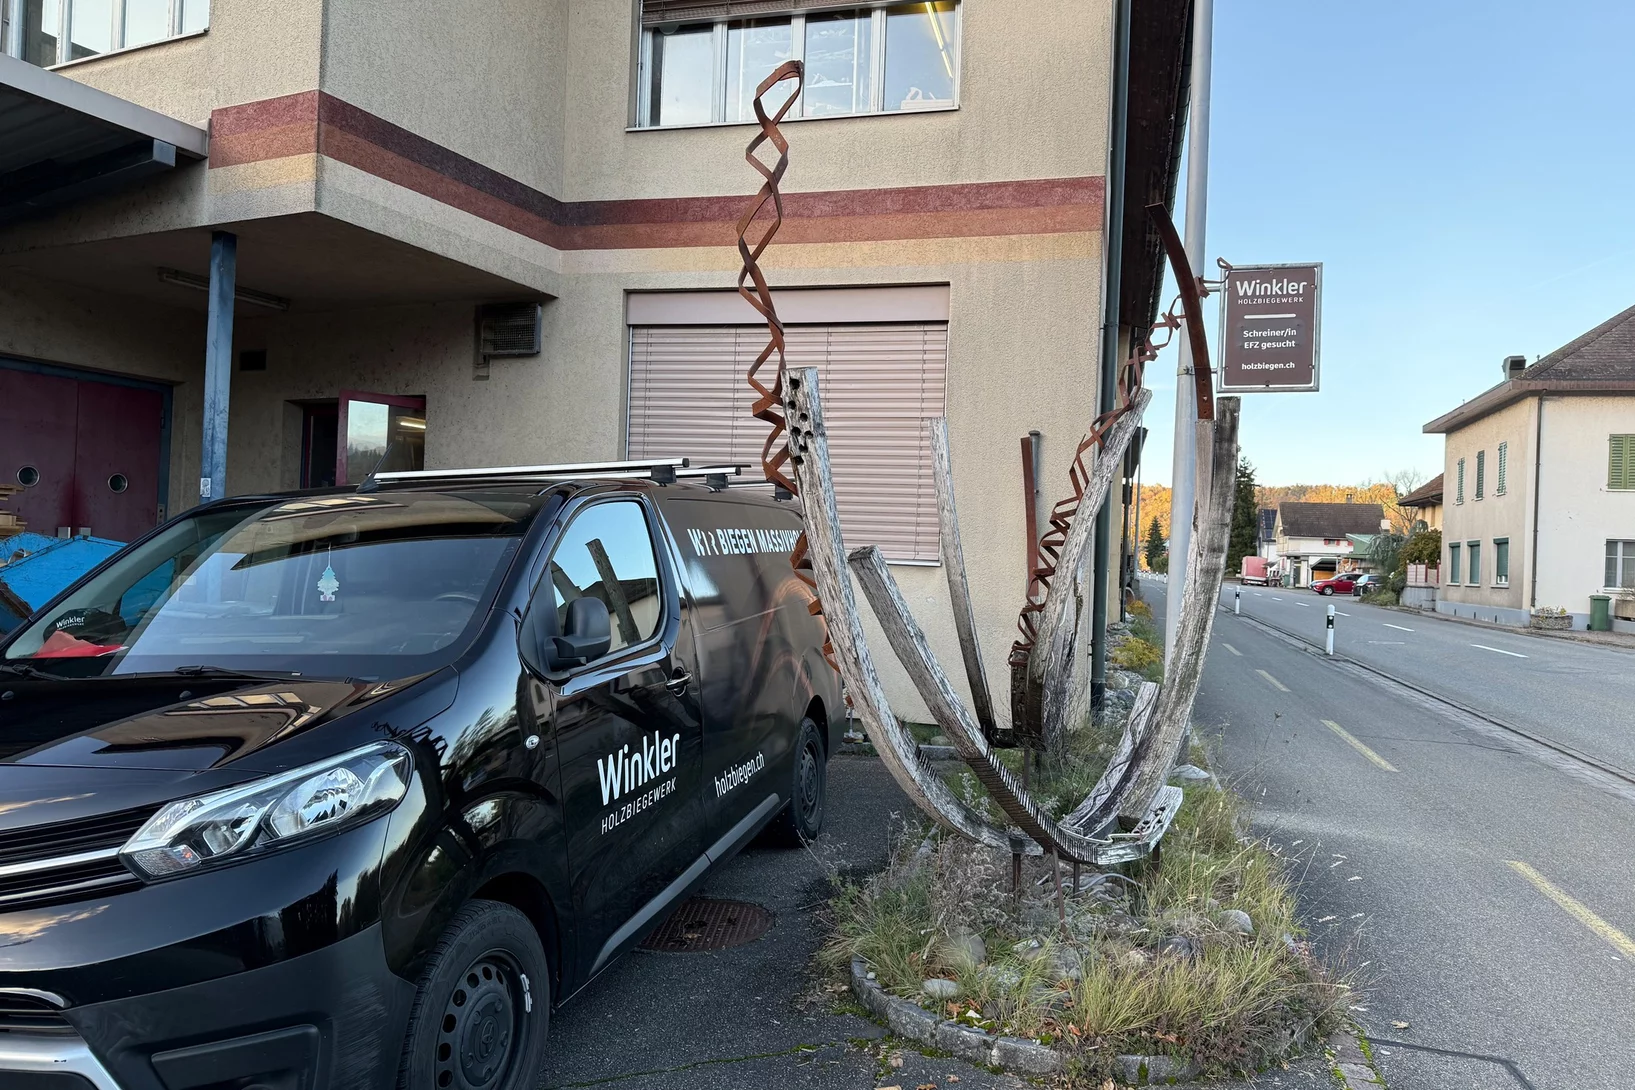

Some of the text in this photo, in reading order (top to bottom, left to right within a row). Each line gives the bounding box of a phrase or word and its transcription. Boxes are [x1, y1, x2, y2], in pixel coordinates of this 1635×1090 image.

[1236, 279, 1307, 296] Winkler
[1238, 297, 1304, 305] HOLZBIEGEWERK
[1243, 328, 1296, 337] Schreiner/in
[1244, 340, 1296, 350] EFZ gesucht
[1241, 362, 1295, 370] holzbiegen.ch
[716, 528, 759, 555] BIEGEN
[56, 616, 85, 628] Winkler
[597, 730, 680, 806] Winkler
[714, 751, 765, 798] holzbiegen.ch
[601, 777, 676, 835] HOLZBIEGEWERK
